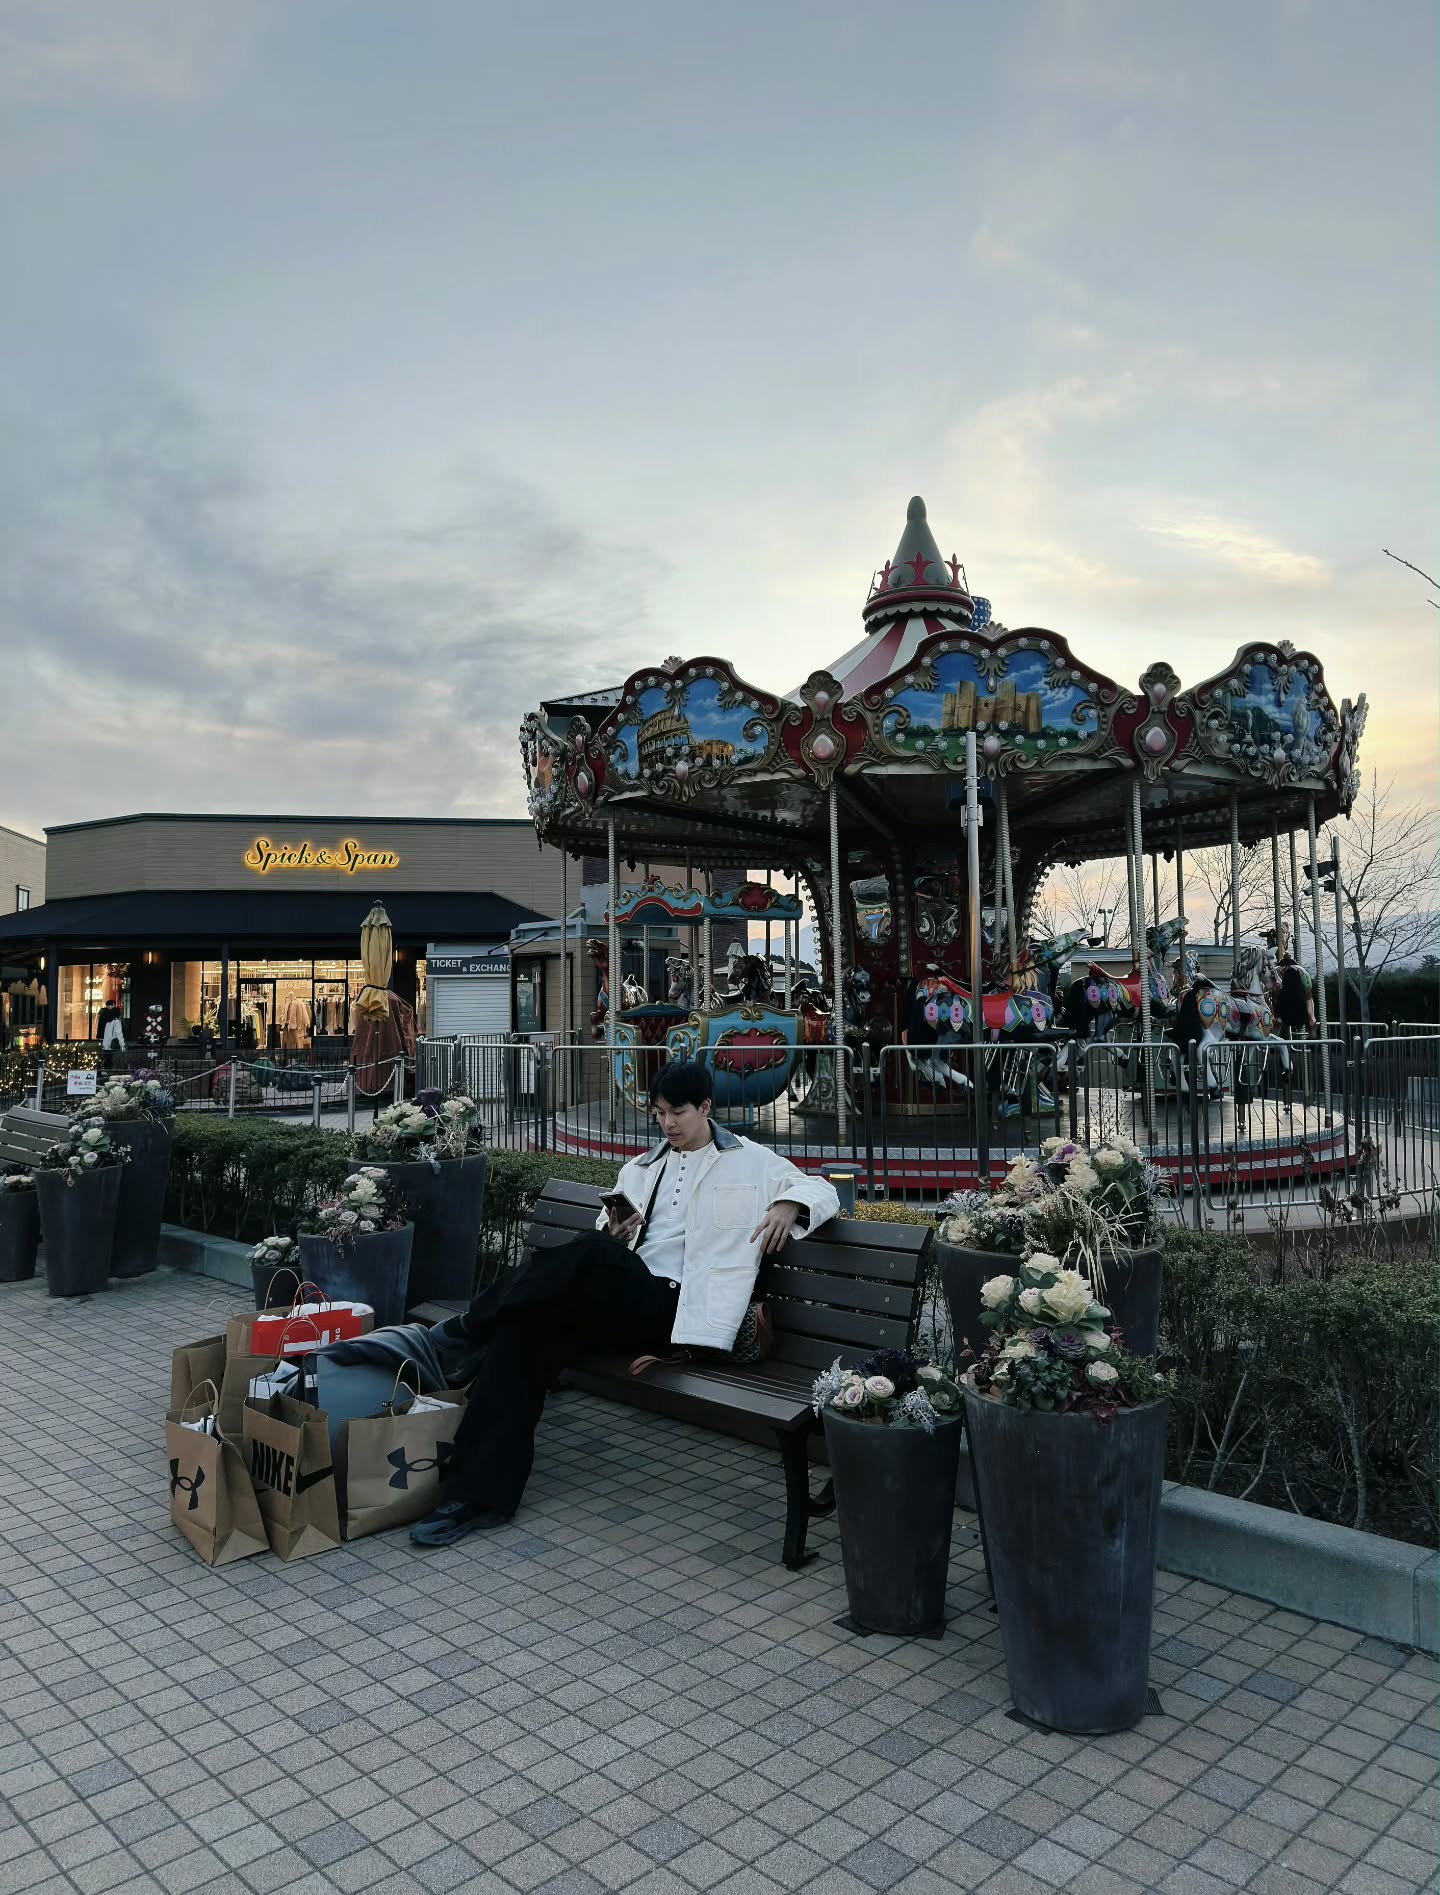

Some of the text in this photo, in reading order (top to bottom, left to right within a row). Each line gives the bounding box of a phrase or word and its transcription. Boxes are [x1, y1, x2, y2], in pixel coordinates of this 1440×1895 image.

[246, 839, 400, 872] Spick & Span
[430, 959, 462, 968] TICKET
[251, 1438, 296, 1498] NIKE
